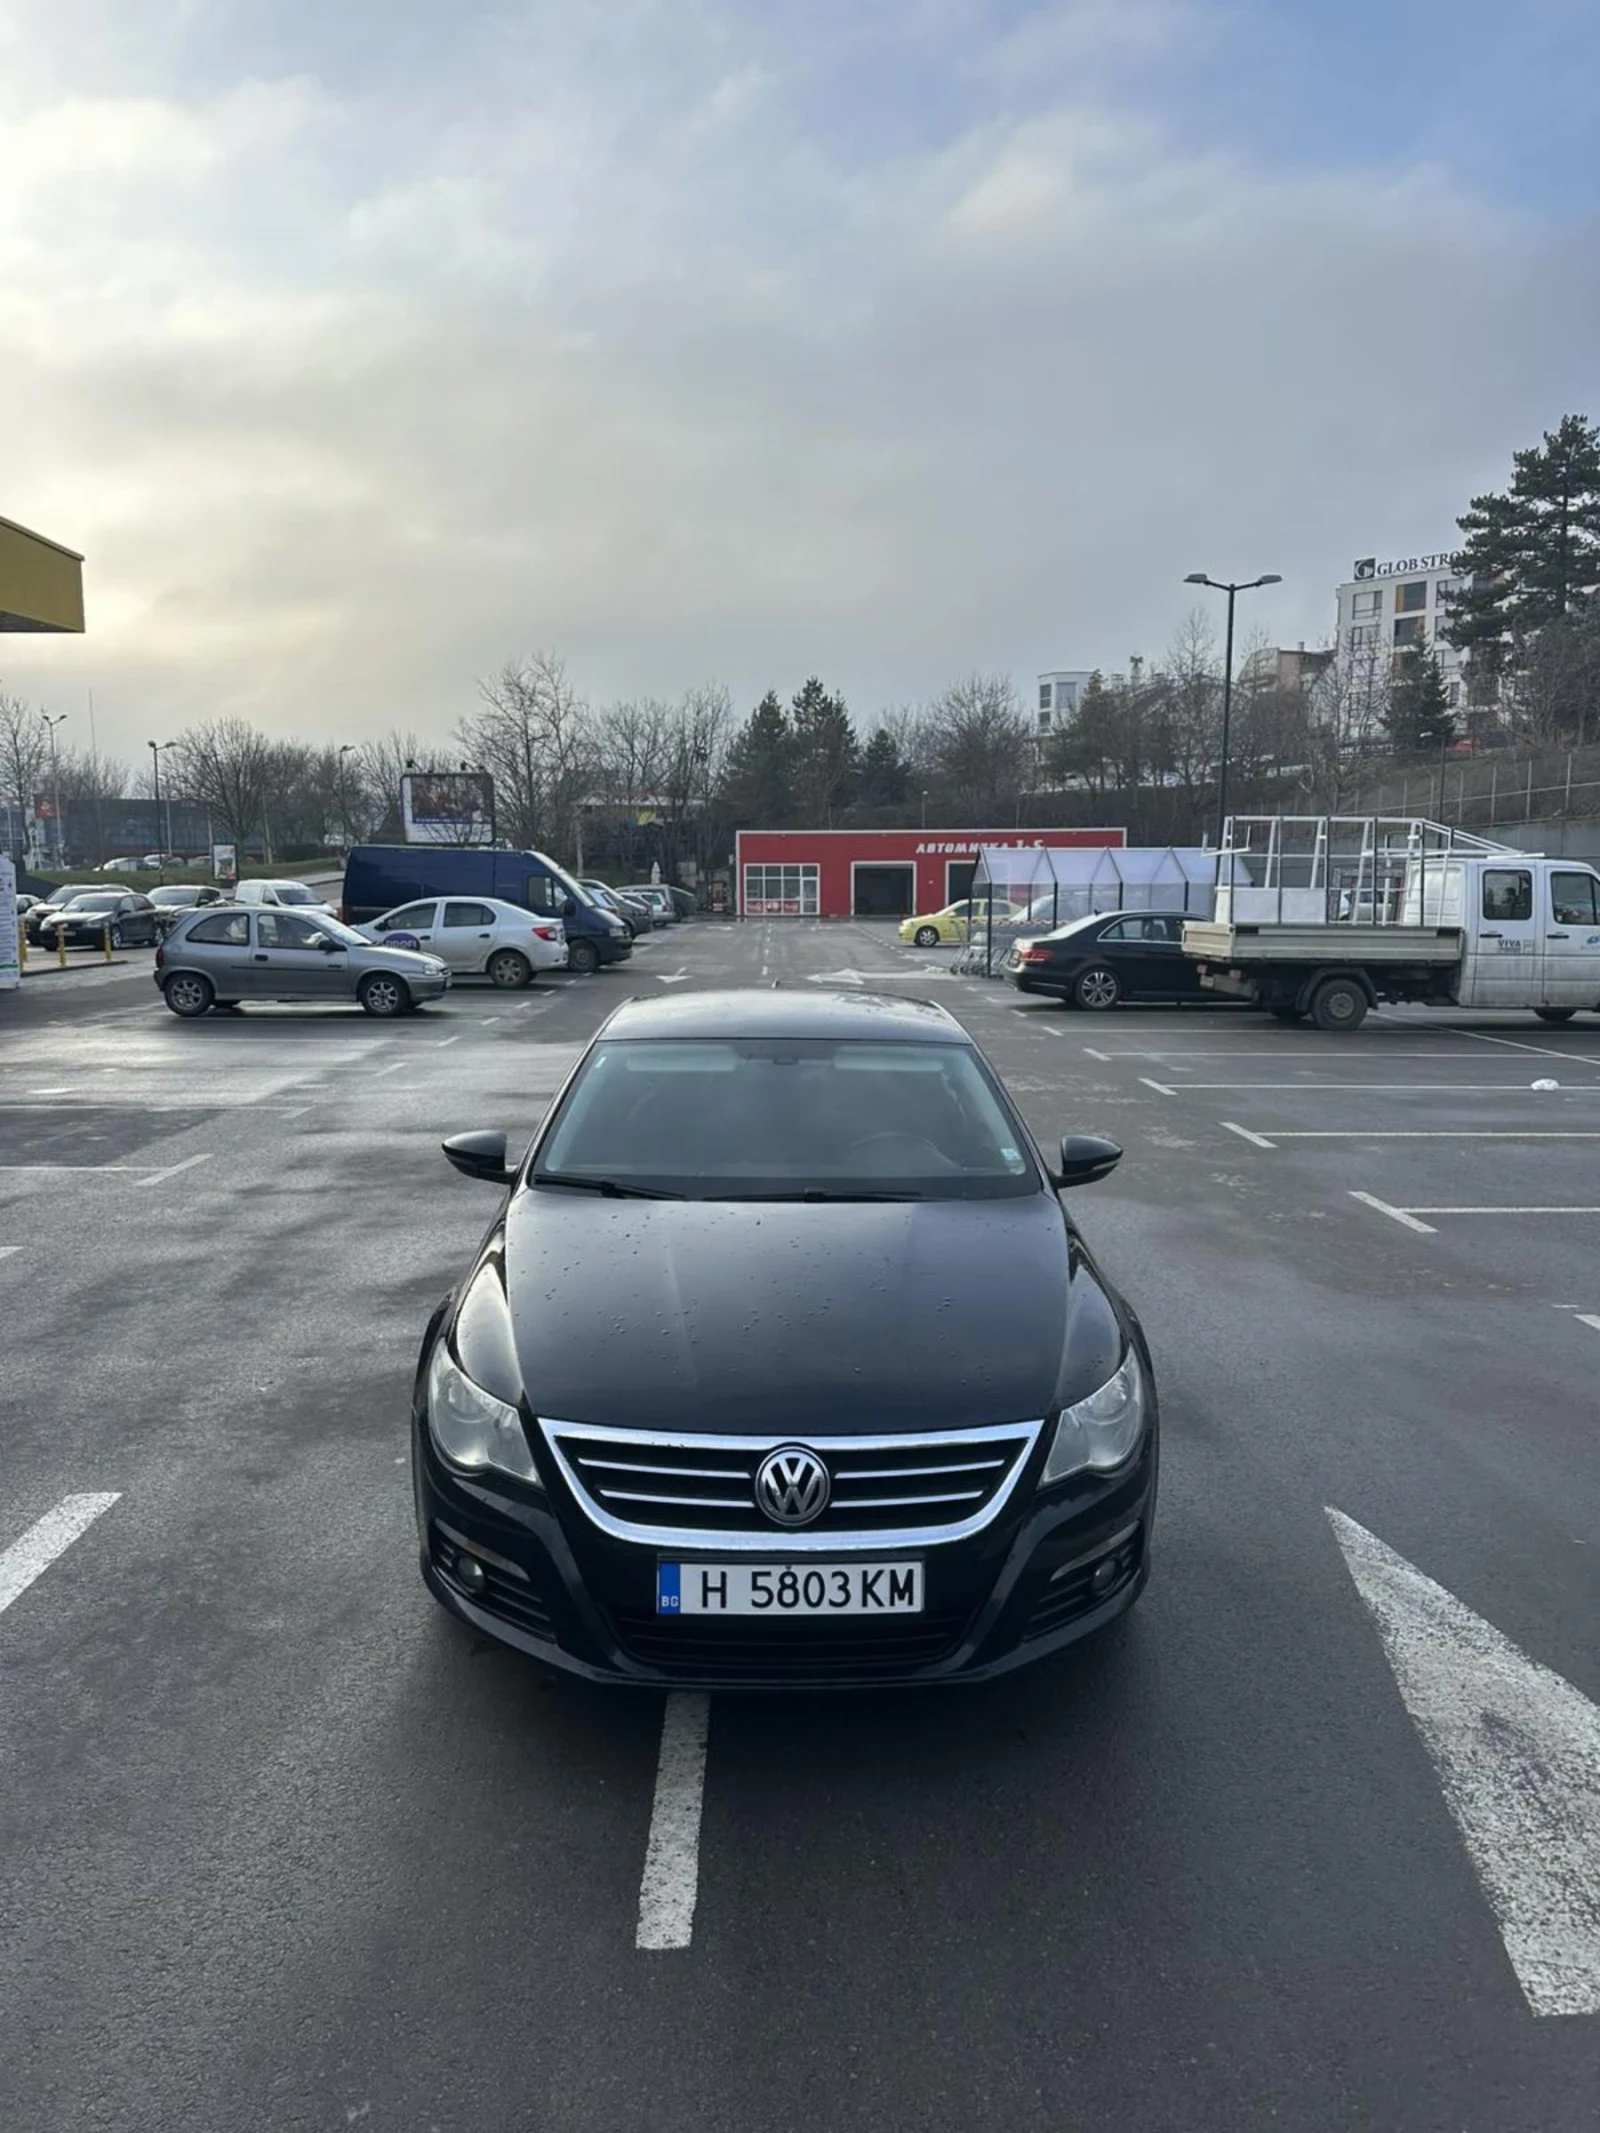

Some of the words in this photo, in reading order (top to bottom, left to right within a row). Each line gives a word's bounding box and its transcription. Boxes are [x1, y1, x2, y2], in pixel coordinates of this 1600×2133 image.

[1377, 558, 1418, 575] GLOB
[1498, 939, 1521, 947] VIVA
[758, 1448, 828, 1524] VW
[701, 1570, 728, 1609] H
[750, 1570, 851, 1609] 5803
[861, 1567, 914, 1608] KM
[661, 1595, 679, 1608] BG
